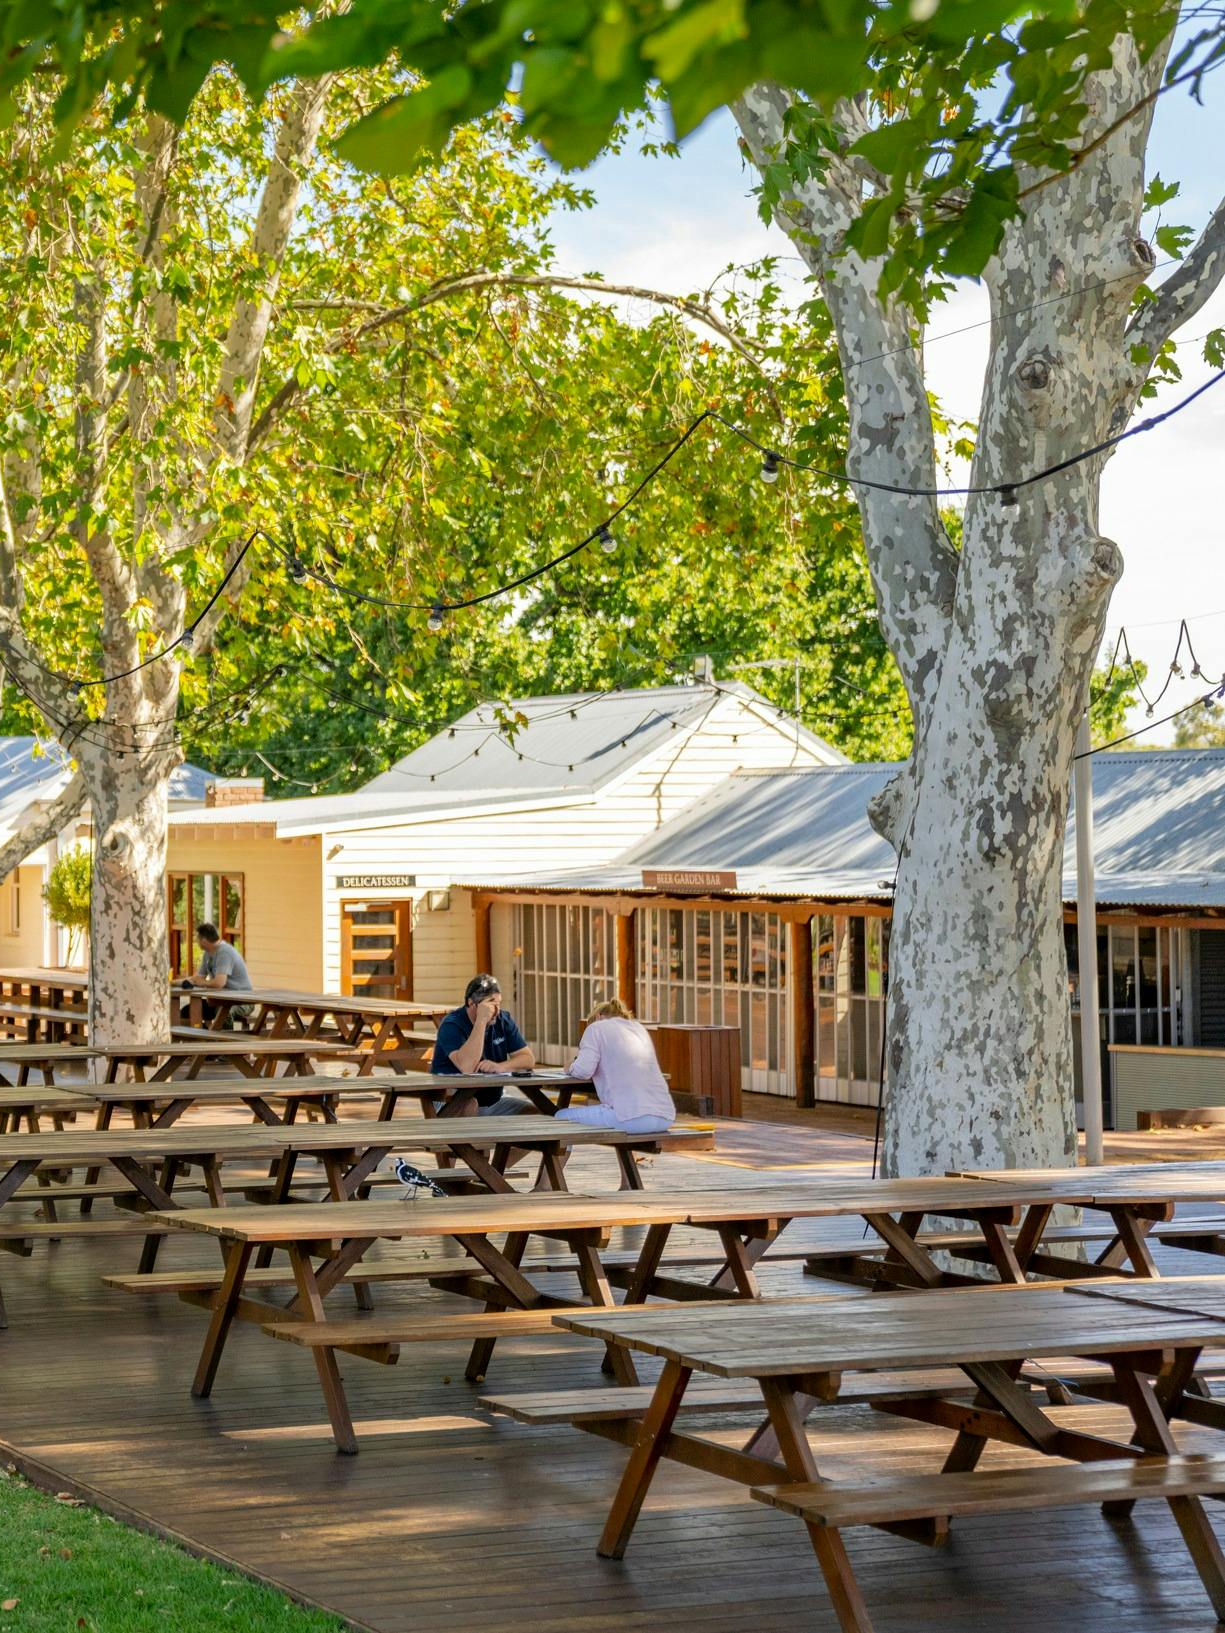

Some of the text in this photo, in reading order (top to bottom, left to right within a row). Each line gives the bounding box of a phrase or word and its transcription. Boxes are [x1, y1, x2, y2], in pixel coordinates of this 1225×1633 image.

[343, 876, 409, 887] DELICATESSEN
[656, 872, 721, 886] BEER GARDEN BAR
